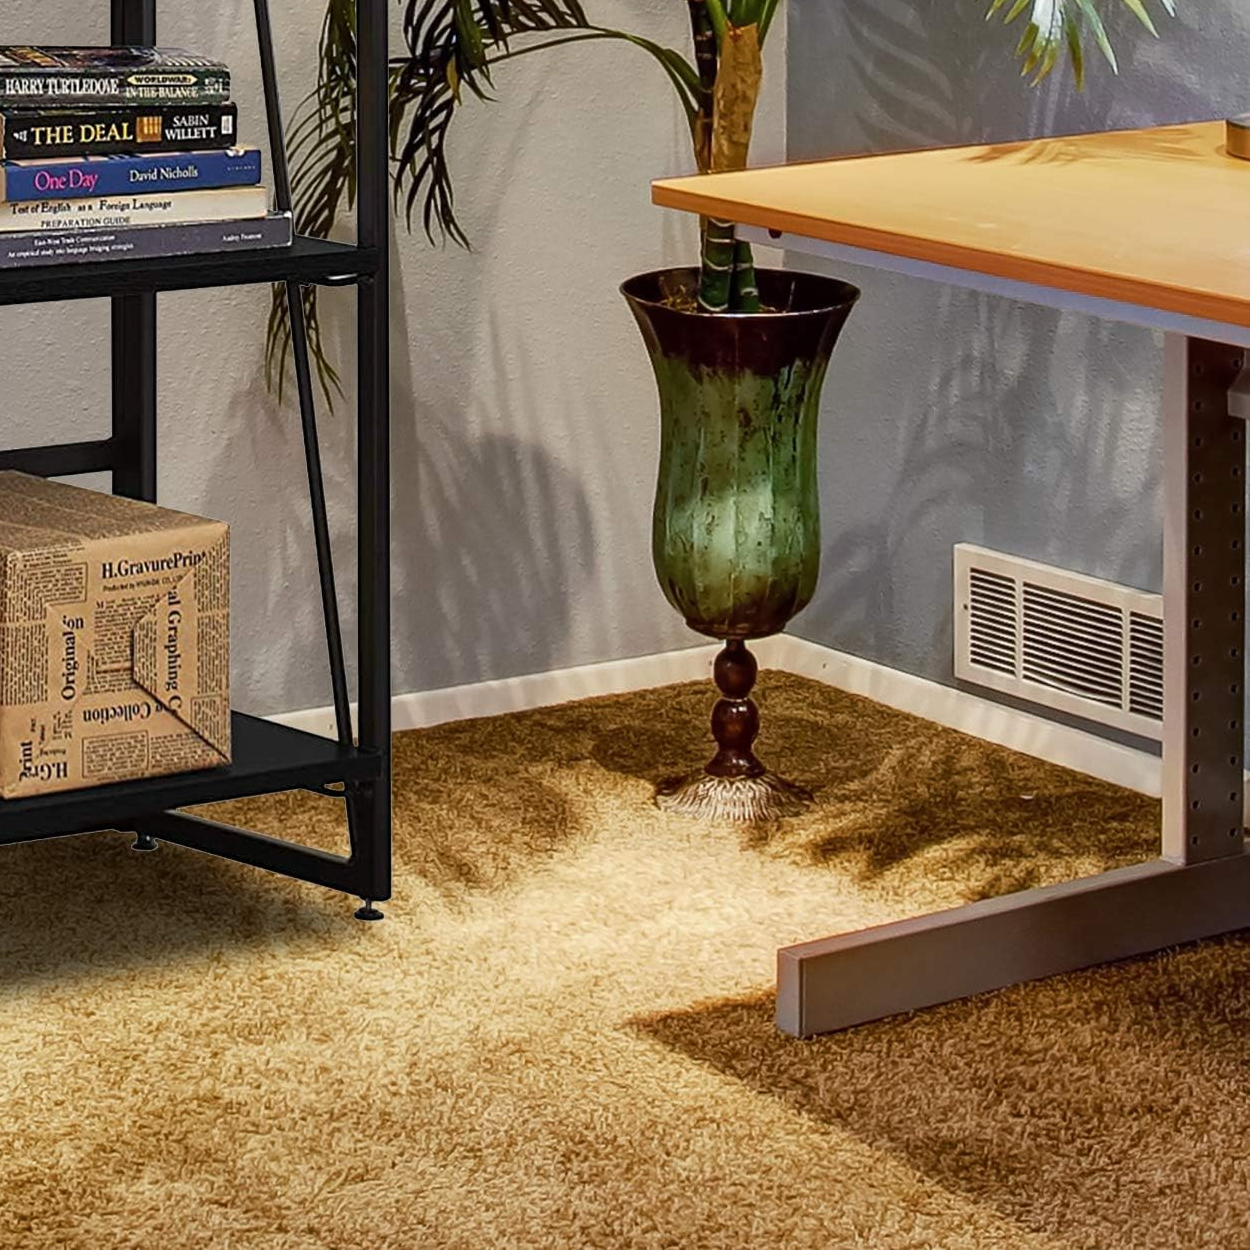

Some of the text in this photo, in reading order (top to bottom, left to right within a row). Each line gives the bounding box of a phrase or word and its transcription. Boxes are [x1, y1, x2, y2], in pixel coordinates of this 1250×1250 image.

[5, 78, 45, 95] HARRY
[46, 77, 119, 95] TURTLEDOVE
[173, 114, 210, 127] SABIN
[30, 122, 134, 145] THE DEAL
[165, 126, 217, 141] WILLETT
[35, 168, 98, 192] One Day
[130, 165, 199, 182] David Nicholls
[10, 203, 29, 214] Test
[31, 202, 41, 213] of
[41, 201, 71, 214] English
[99, 199, 130, 211] Foreign
[132, 198, 172, 211] Language
[41, 216, 130, 227] PREPARATION GUIDE
[164, 610, 182, 692] Graphing
[61, 631, 79, 701] Original
[83, 701, 151, 725] Collection
